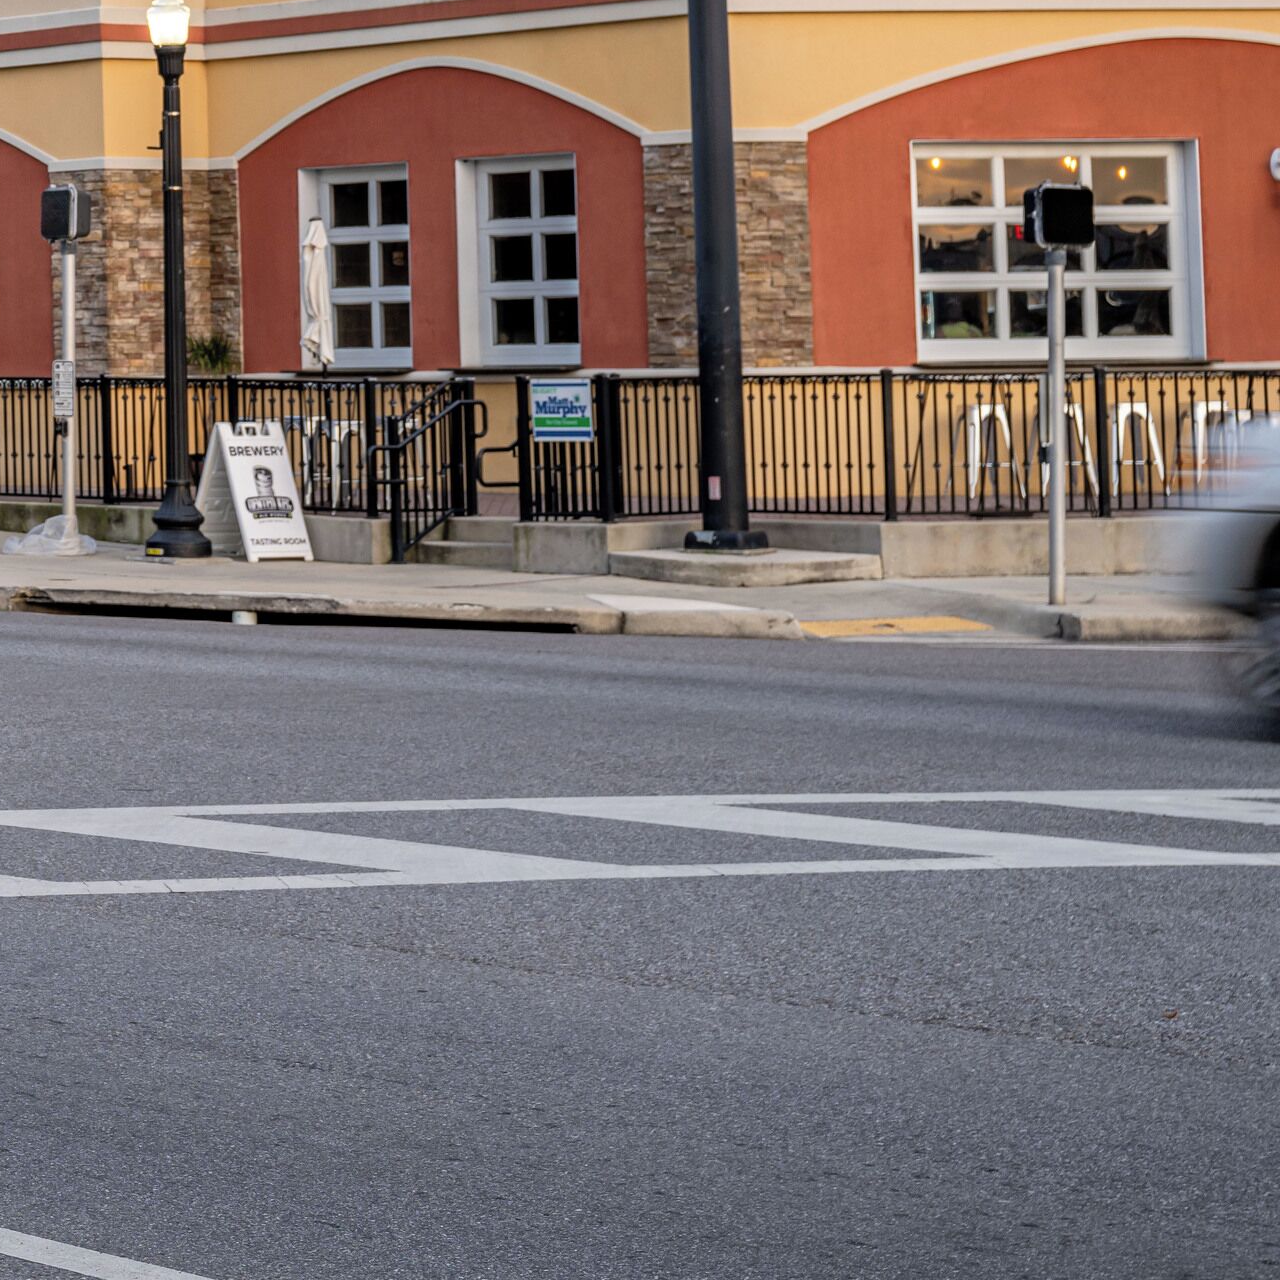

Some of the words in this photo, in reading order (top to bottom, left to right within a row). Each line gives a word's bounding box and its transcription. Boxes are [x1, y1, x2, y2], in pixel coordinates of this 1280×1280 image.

[547, 395, 569, 405] Matt
[535, 400, 587, 419] Murphy
[228, 445, 284, 457] BREWERY
[250, 538, 282, 546] TASTING
[283, 537, 307, 546] ROOM
